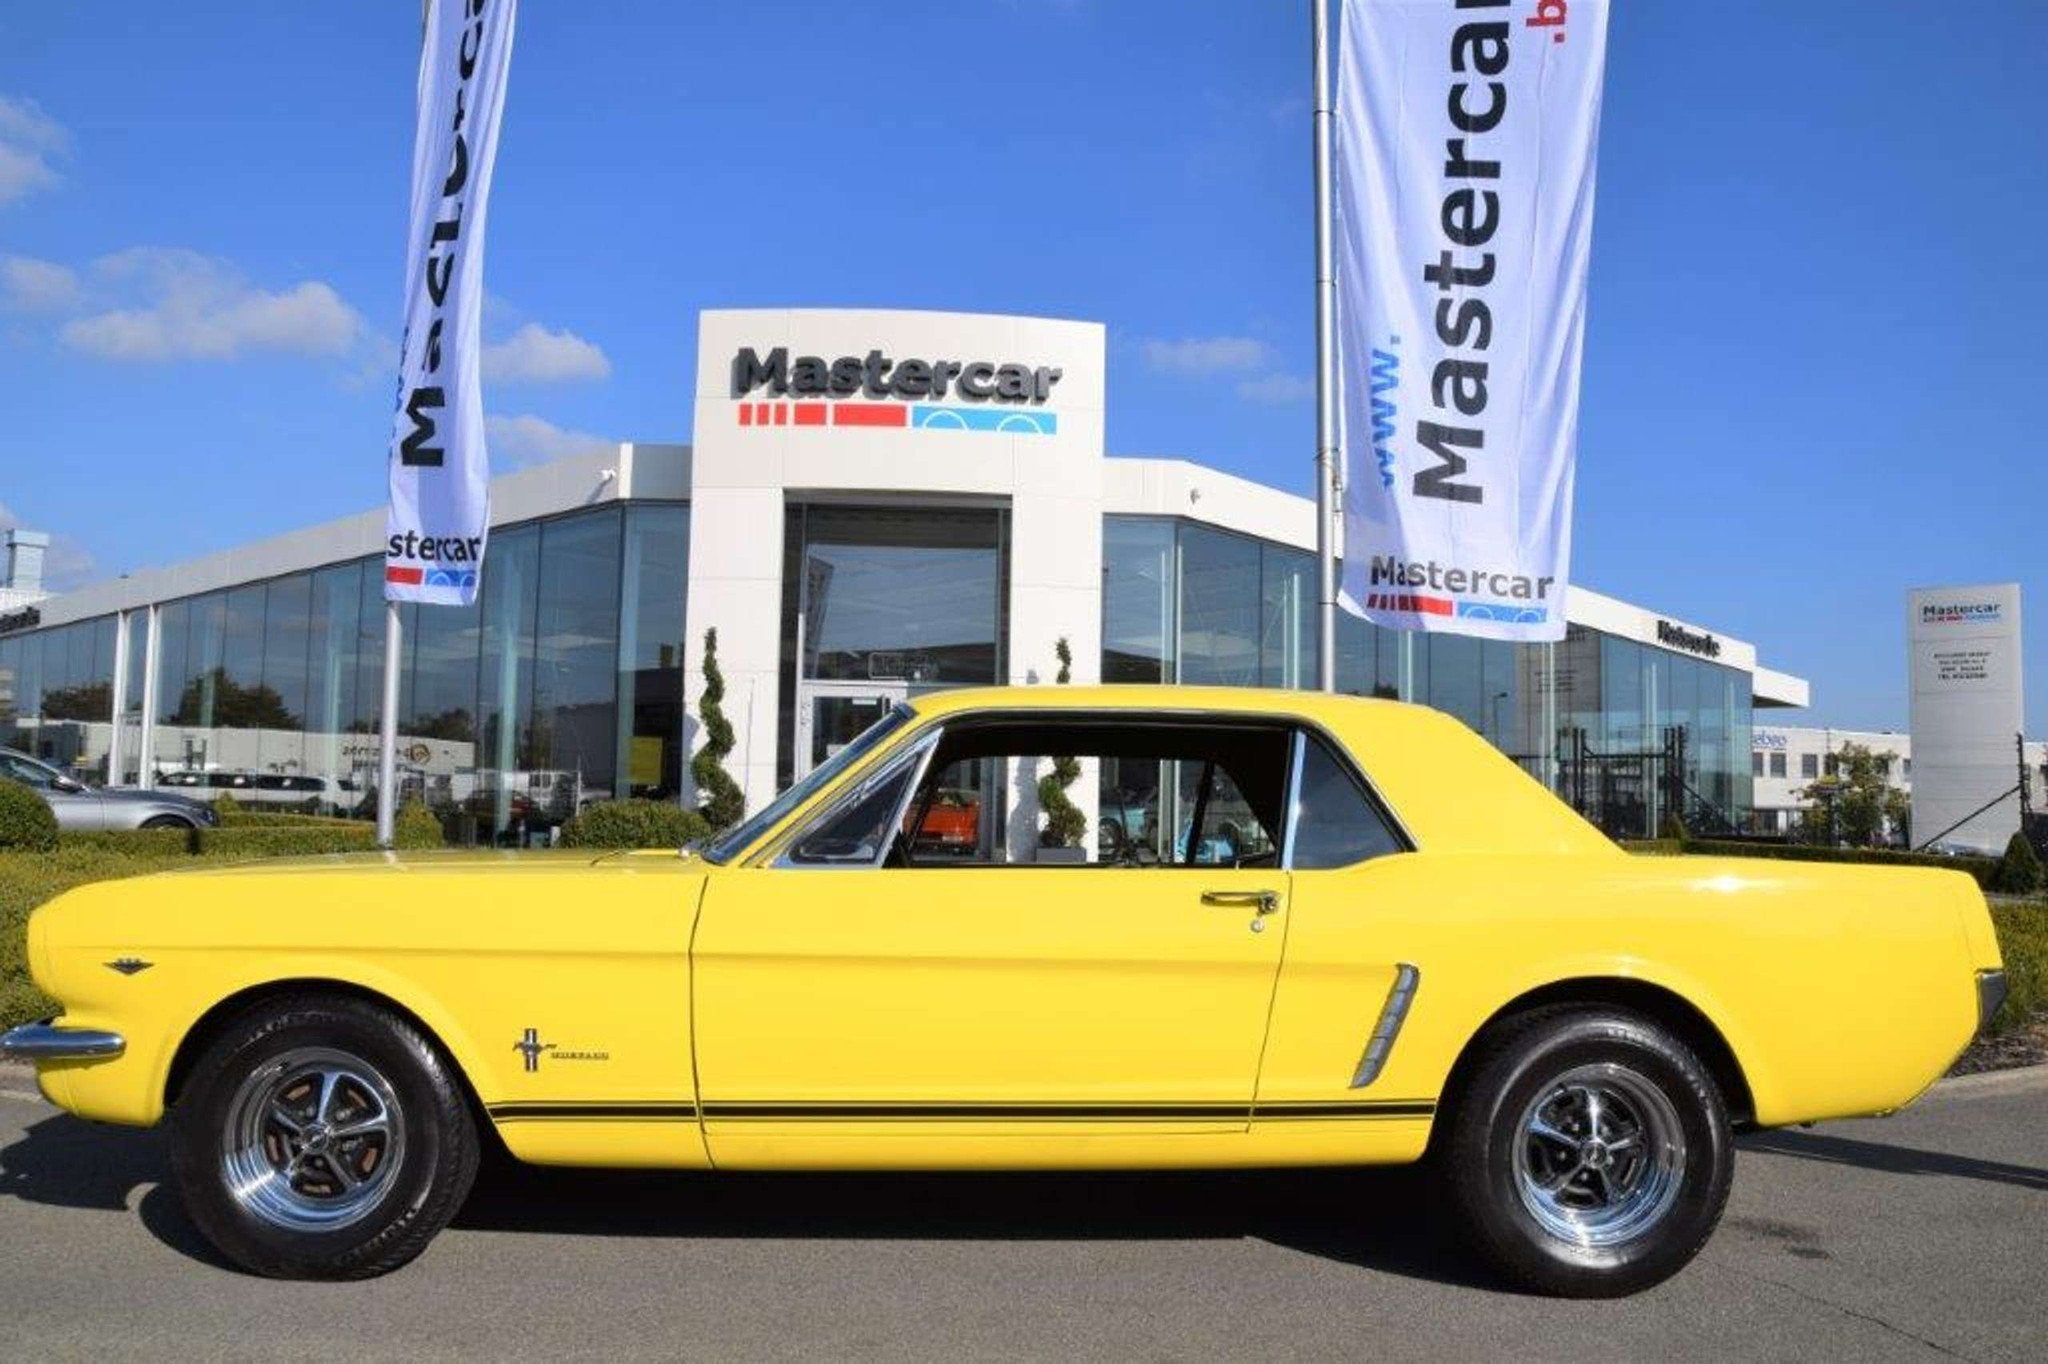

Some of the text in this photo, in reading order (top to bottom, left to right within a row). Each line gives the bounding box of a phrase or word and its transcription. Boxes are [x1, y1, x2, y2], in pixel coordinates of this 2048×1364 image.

[732, 346, 1063, 406] Mastercar
[1370, 555, 1555, 600] Mastercar
[1923, 604, 2002, 616] Mastercar
